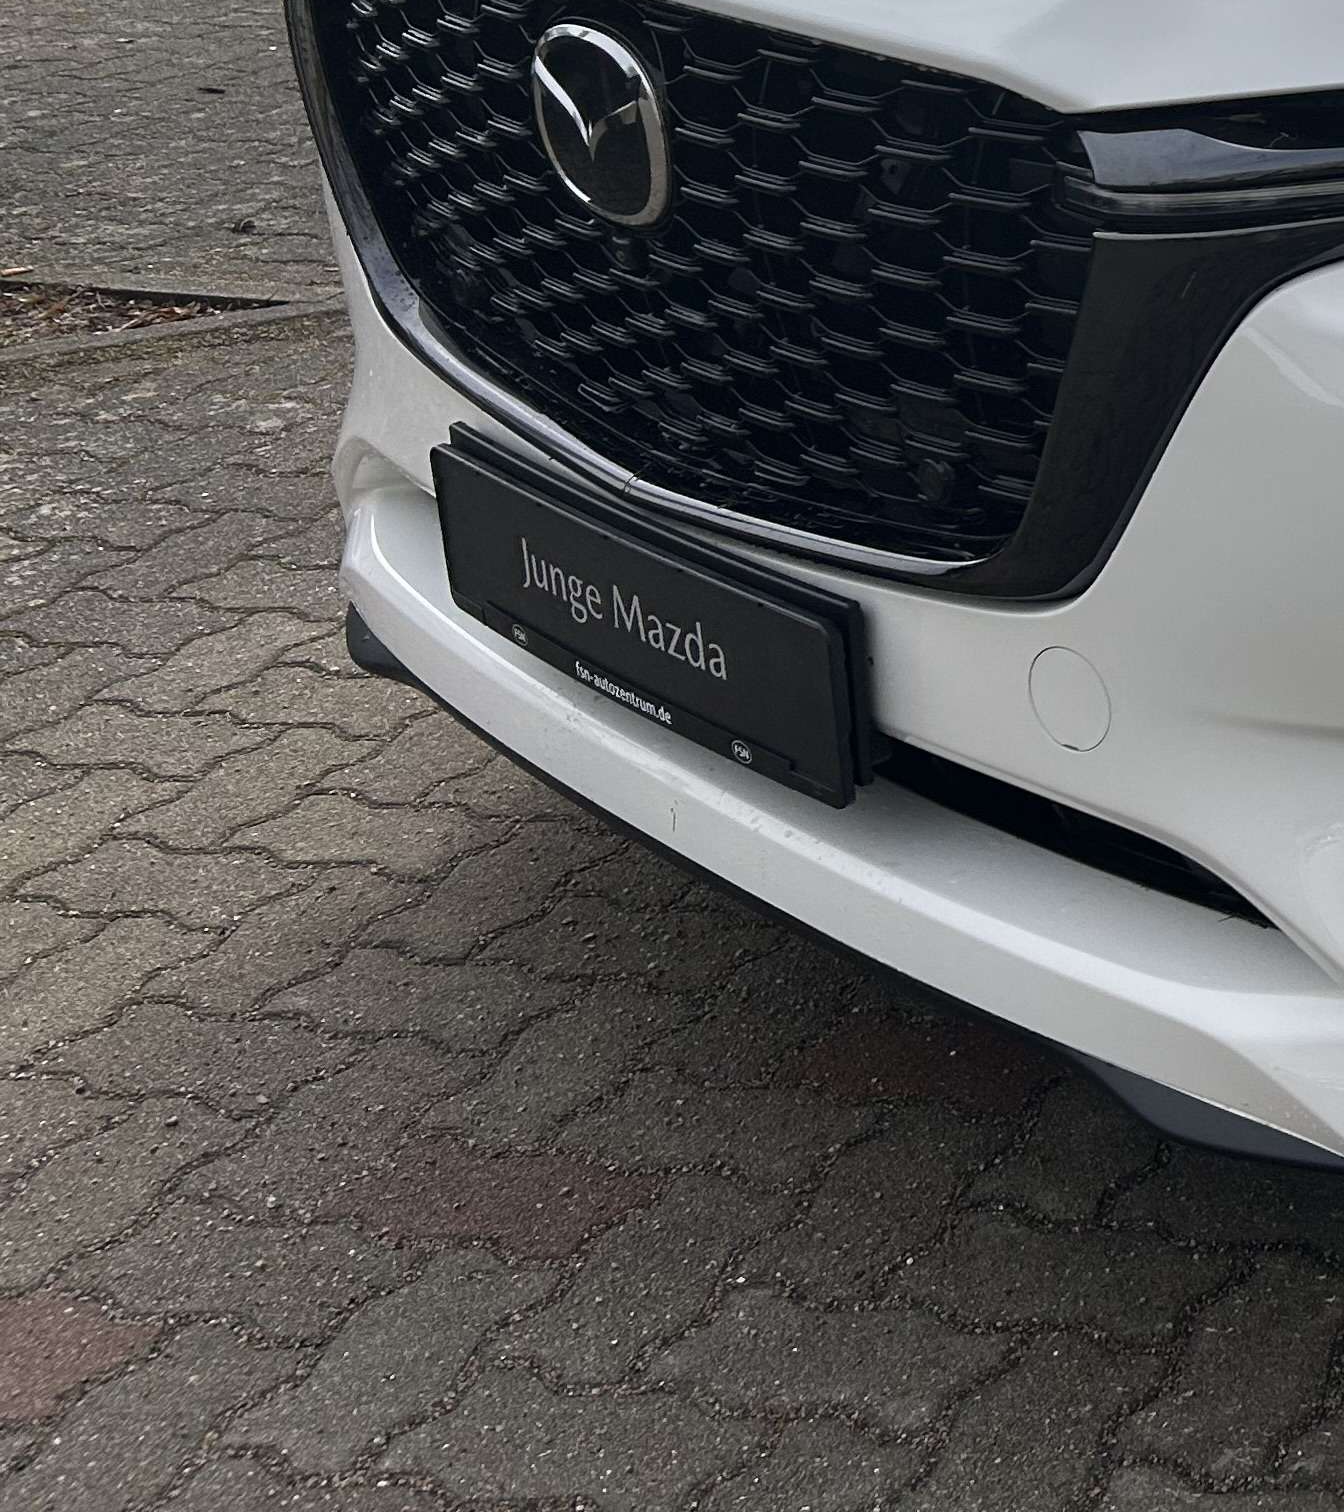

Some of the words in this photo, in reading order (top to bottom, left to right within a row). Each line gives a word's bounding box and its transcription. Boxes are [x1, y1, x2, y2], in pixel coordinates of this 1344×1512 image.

[520, 536, 603, 624] Junge
[612, 584, 727, 681] Mazda
[575, 660, 673, 725] fsn-autozentrum.de
